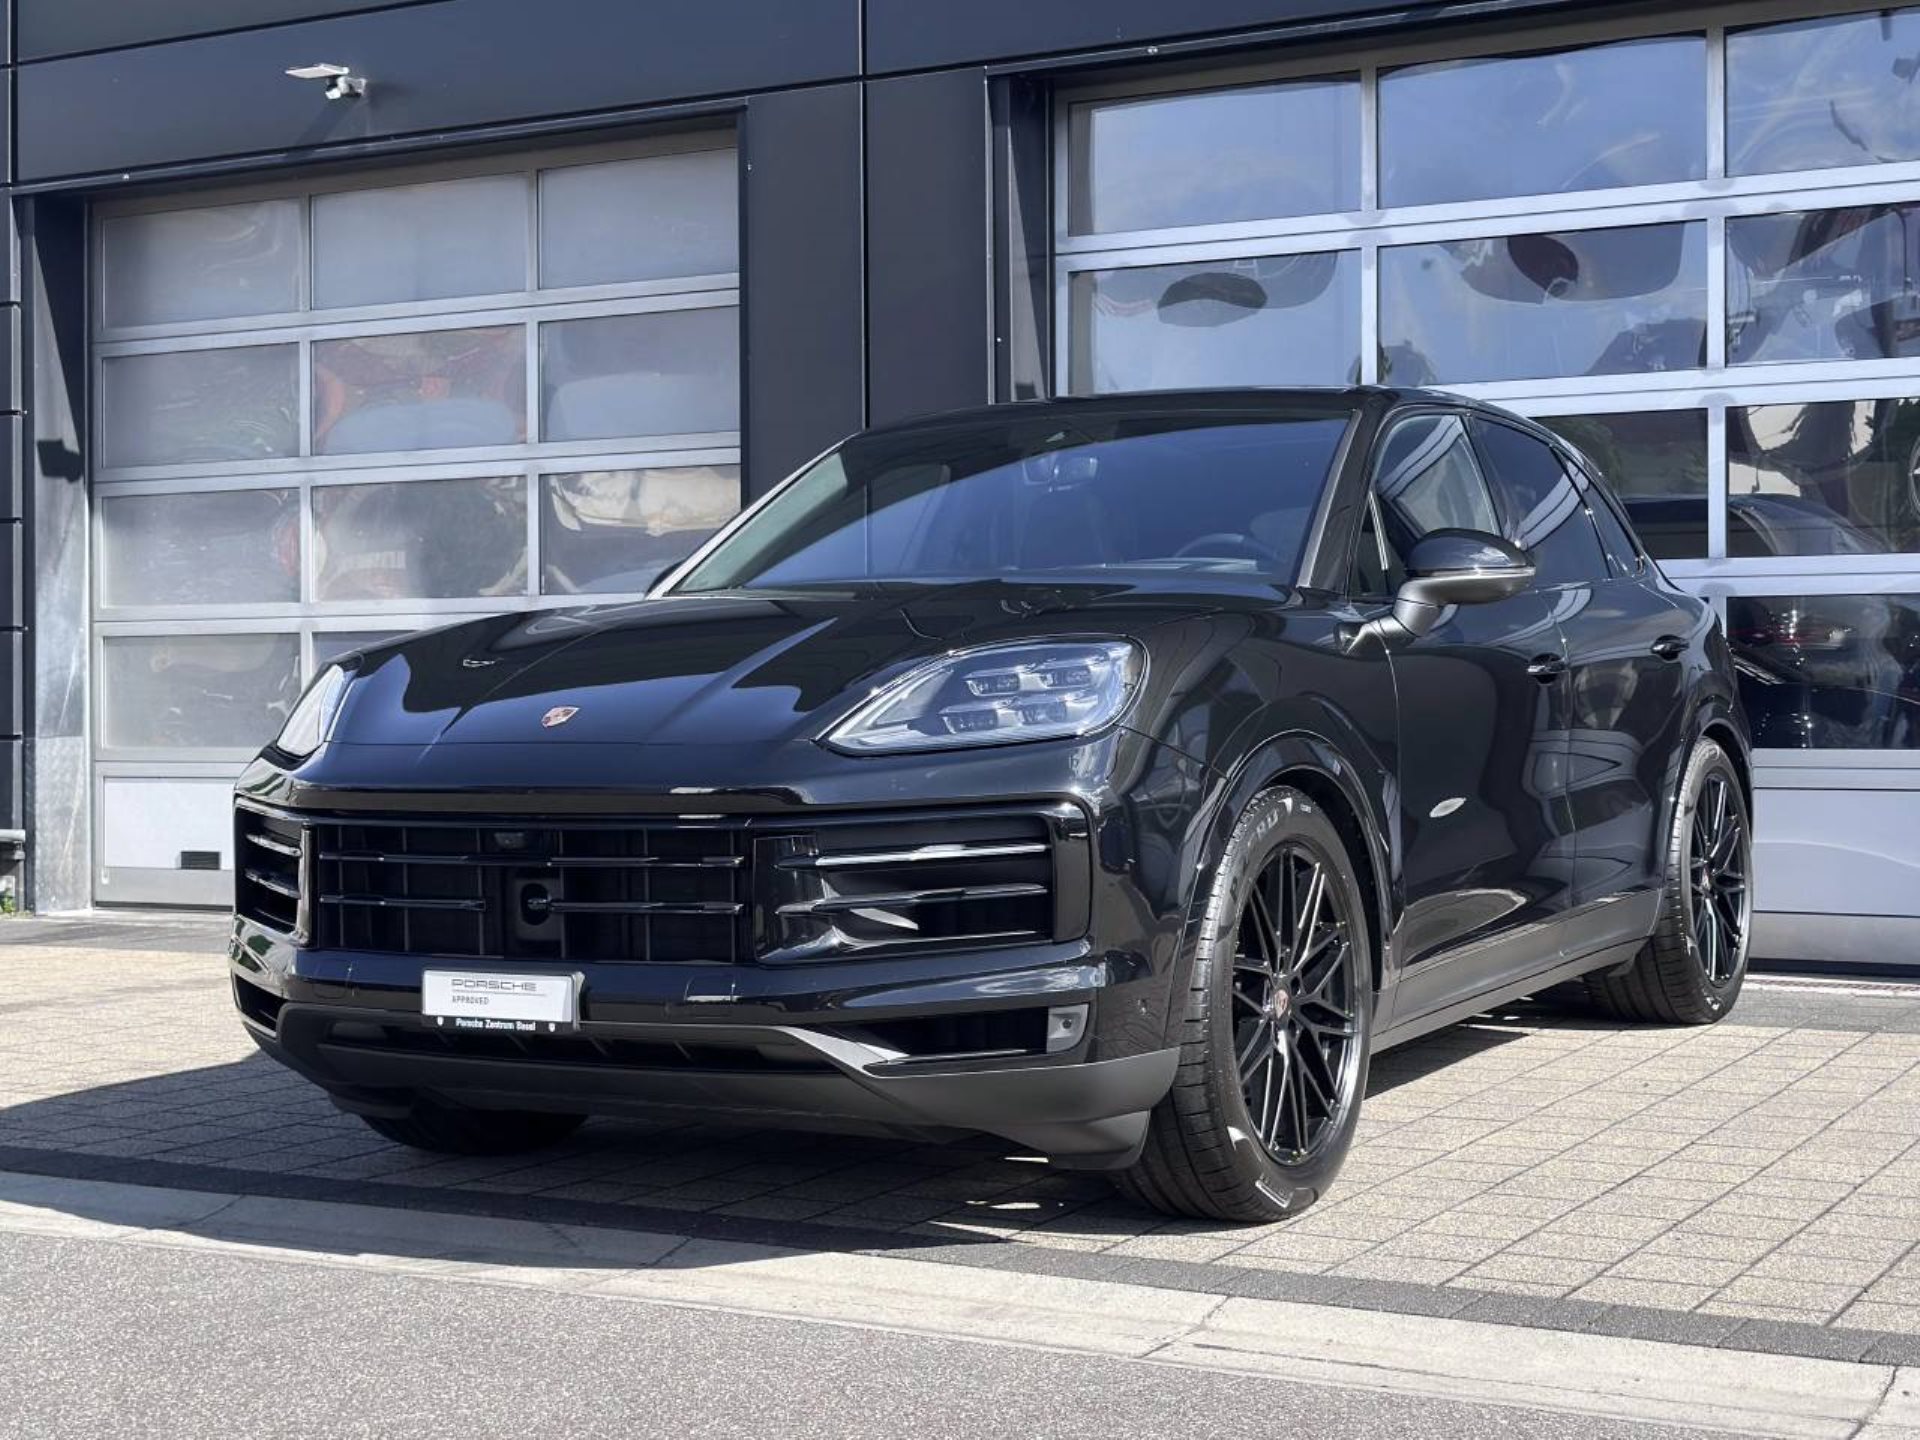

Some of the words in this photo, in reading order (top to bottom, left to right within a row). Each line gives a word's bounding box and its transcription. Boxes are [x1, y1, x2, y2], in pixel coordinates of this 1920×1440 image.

[451, 978, 537, 992] PORSCHE
[451, 995, 490, 1006] APPROVED
[455, 1018, 484, 1028] Porsche
[485, 1019, 515, 1030] Zentrum
[516, 1020, 536, 1031] Basel
